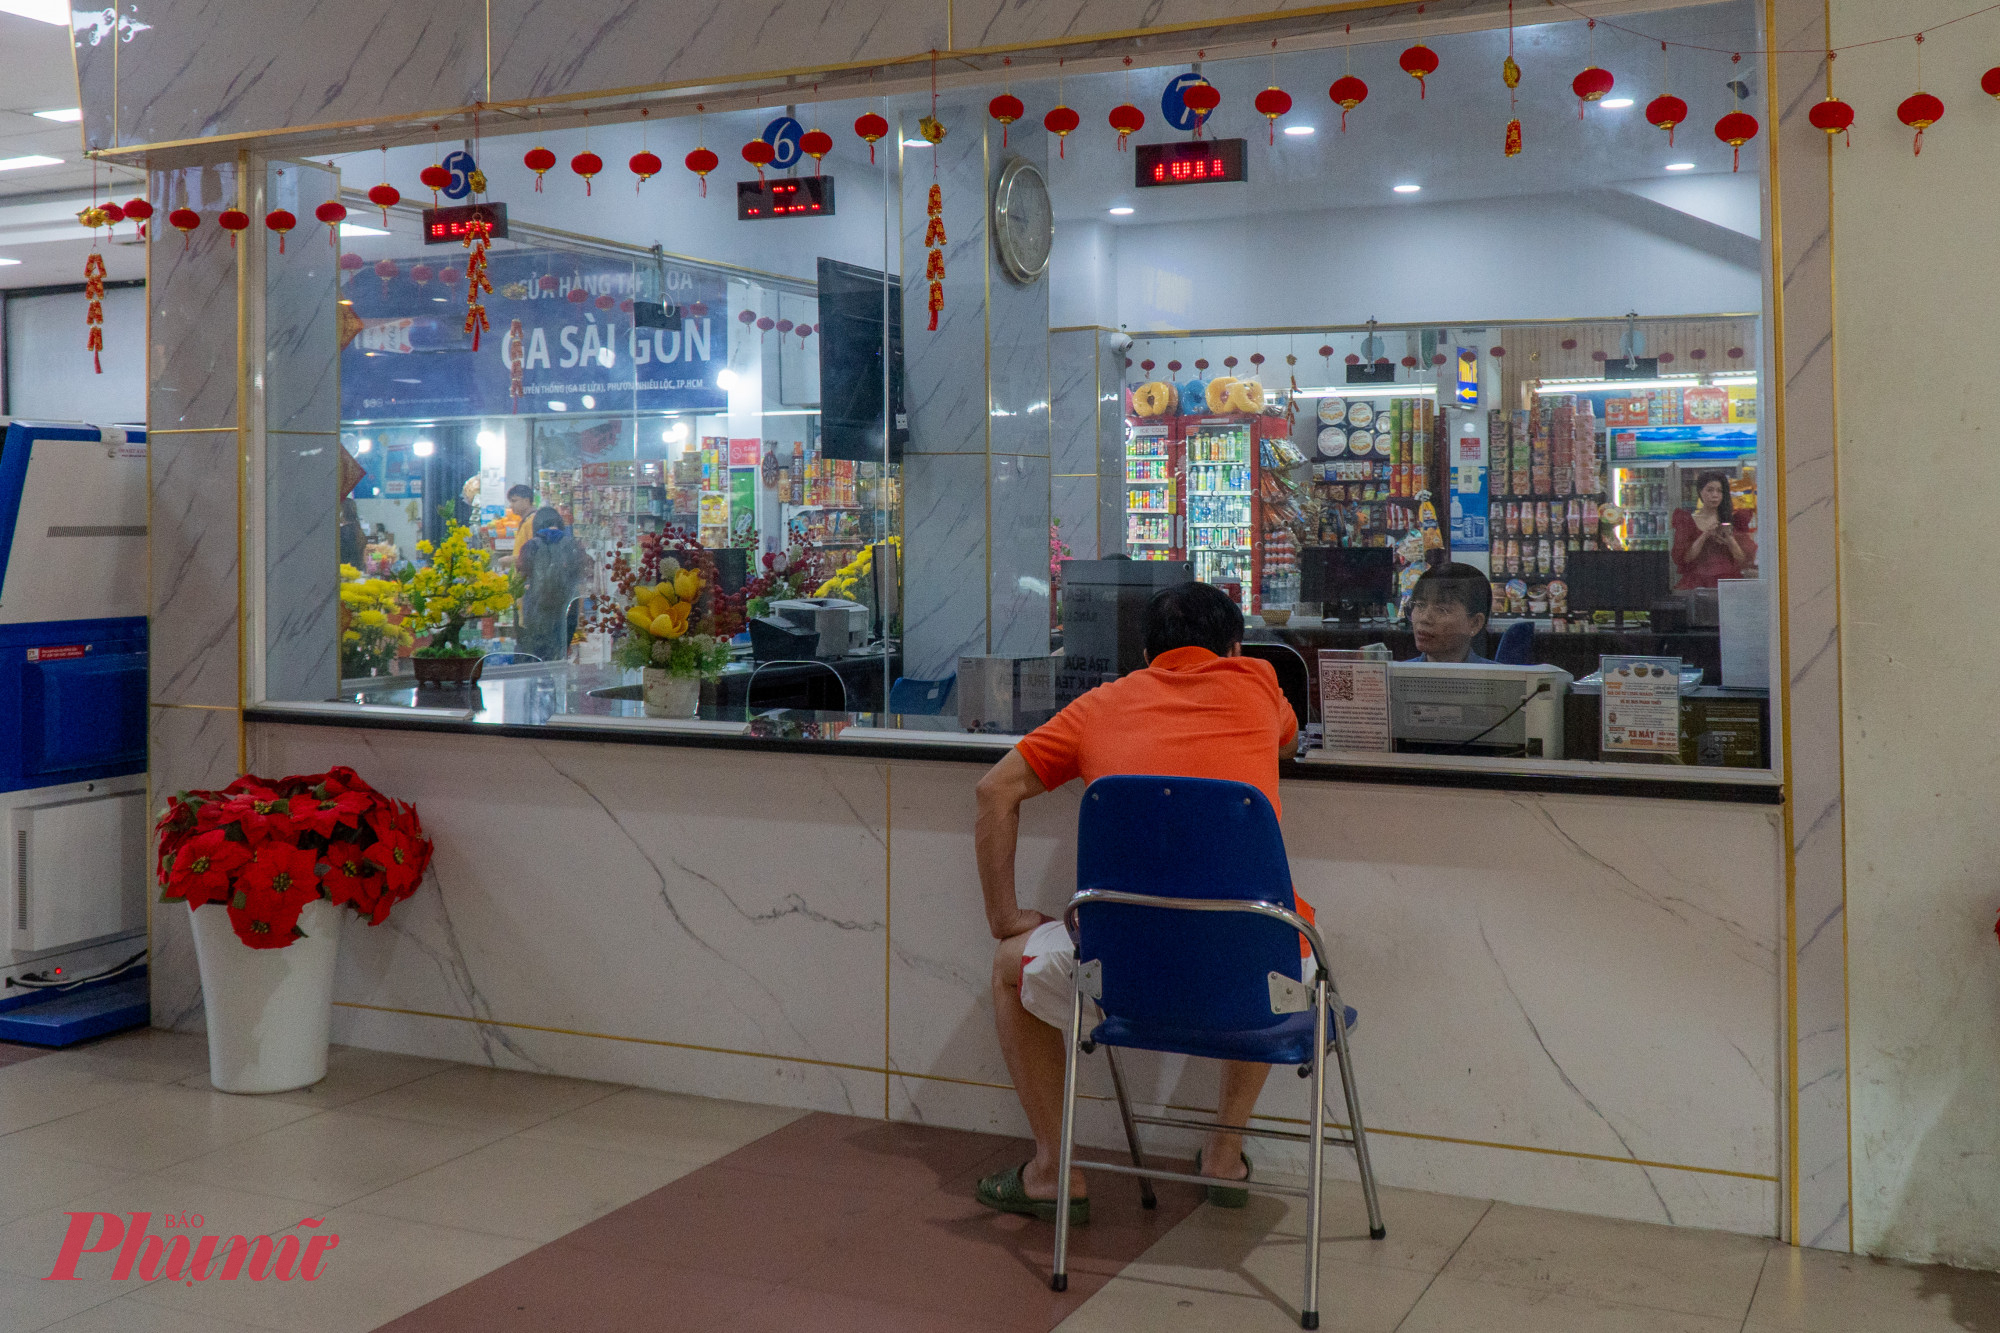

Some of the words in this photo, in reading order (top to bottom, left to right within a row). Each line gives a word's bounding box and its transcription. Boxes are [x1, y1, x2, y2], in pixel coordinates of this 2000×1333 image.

[773, 121, 795, 162] 6
[447, 152, 466, 193] 5
[501, 327, 551, 370] GA
[559, 313, 615, 368] SÀI
